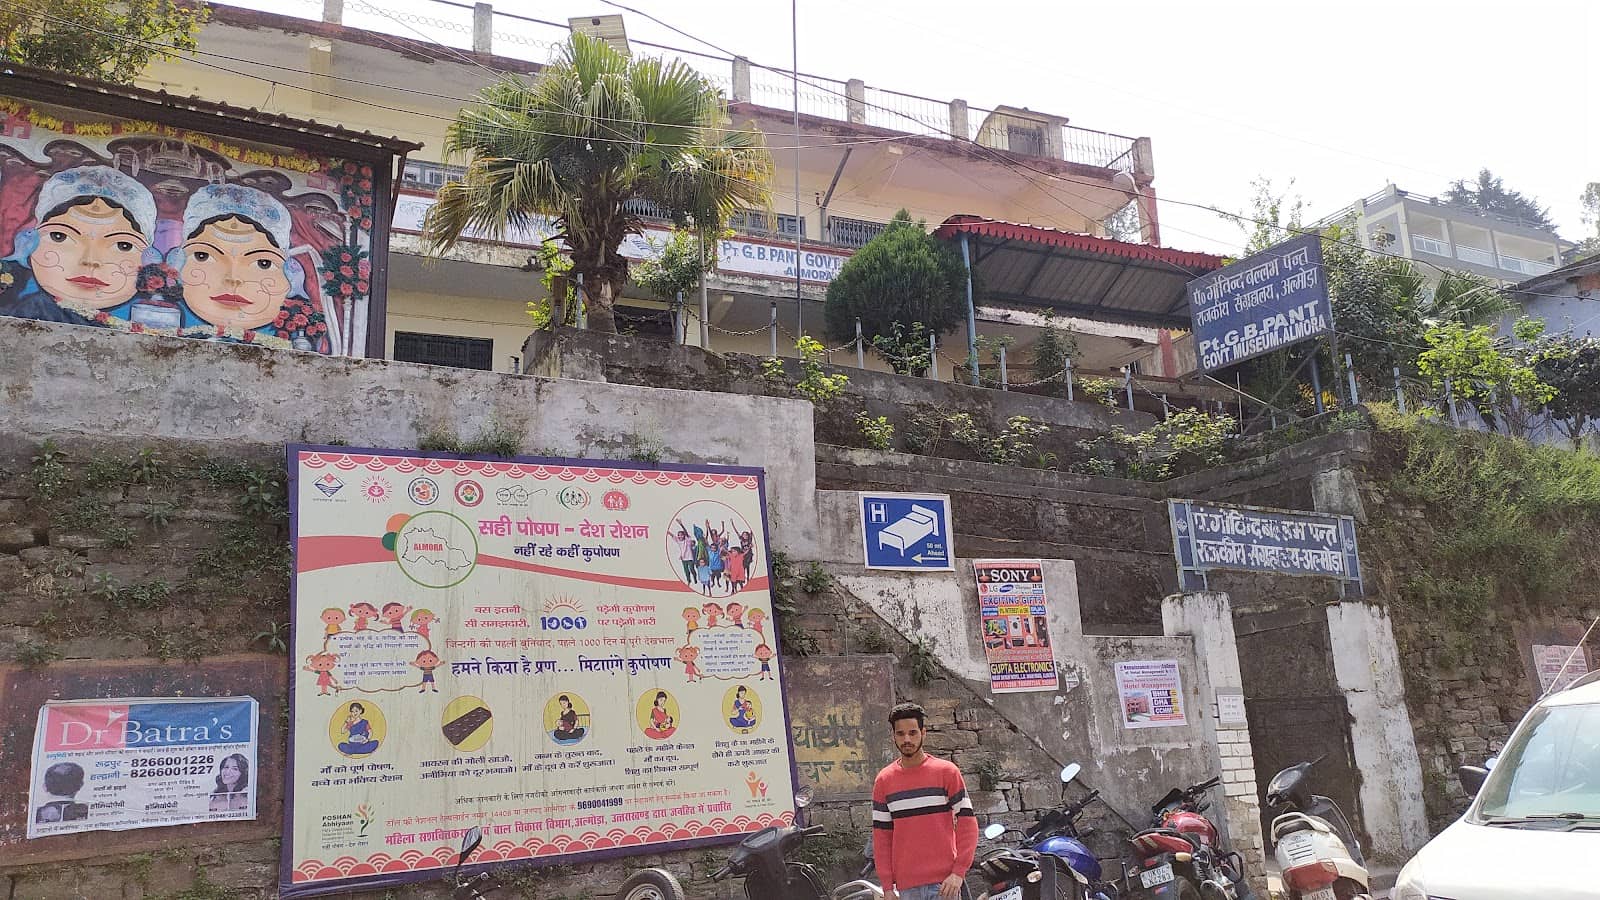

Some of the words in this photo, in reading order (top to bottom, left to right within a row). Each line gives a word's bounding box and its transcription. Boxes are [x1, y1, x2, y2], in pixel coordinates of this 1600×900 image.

[870, 503, 886, 522] H
[478, 514, 513, 537] सही
[516, 517, 560, 537] पोषण
[578, 519, 606, 538] देश
[608, 520, 649, 539] रोशन
[413, 543, 443, 552] ALMORA
[513, 543, 537, 557] नहीं
[538, 544, 553, 558] रहे
[556, 544, 581, 557] कहीं
[582, 545, 620, 562] कुपोषण
[990, 569, 1030, 582] SONY
[451, 657, 482, 677] हमने
[485, 656, 519, 675] किया
[520, 655, 532, 676] है
[627, 654, 672, 676] कुपोषण
[990, 662, 1014, 675] GUPTA
[59, 721, 110, 747] Dr
[119, 717, 233, 745] Batra's
[130, 755, 215, 768] 8266001226
[130, 765, 214, 779] 8266001227
[577, 797, 623, 810] 9690041999
[322, 813, 352, 821] POSHAN
[385, 832, 415, 845] महिला
[494, 824, 512, 835] बाल
